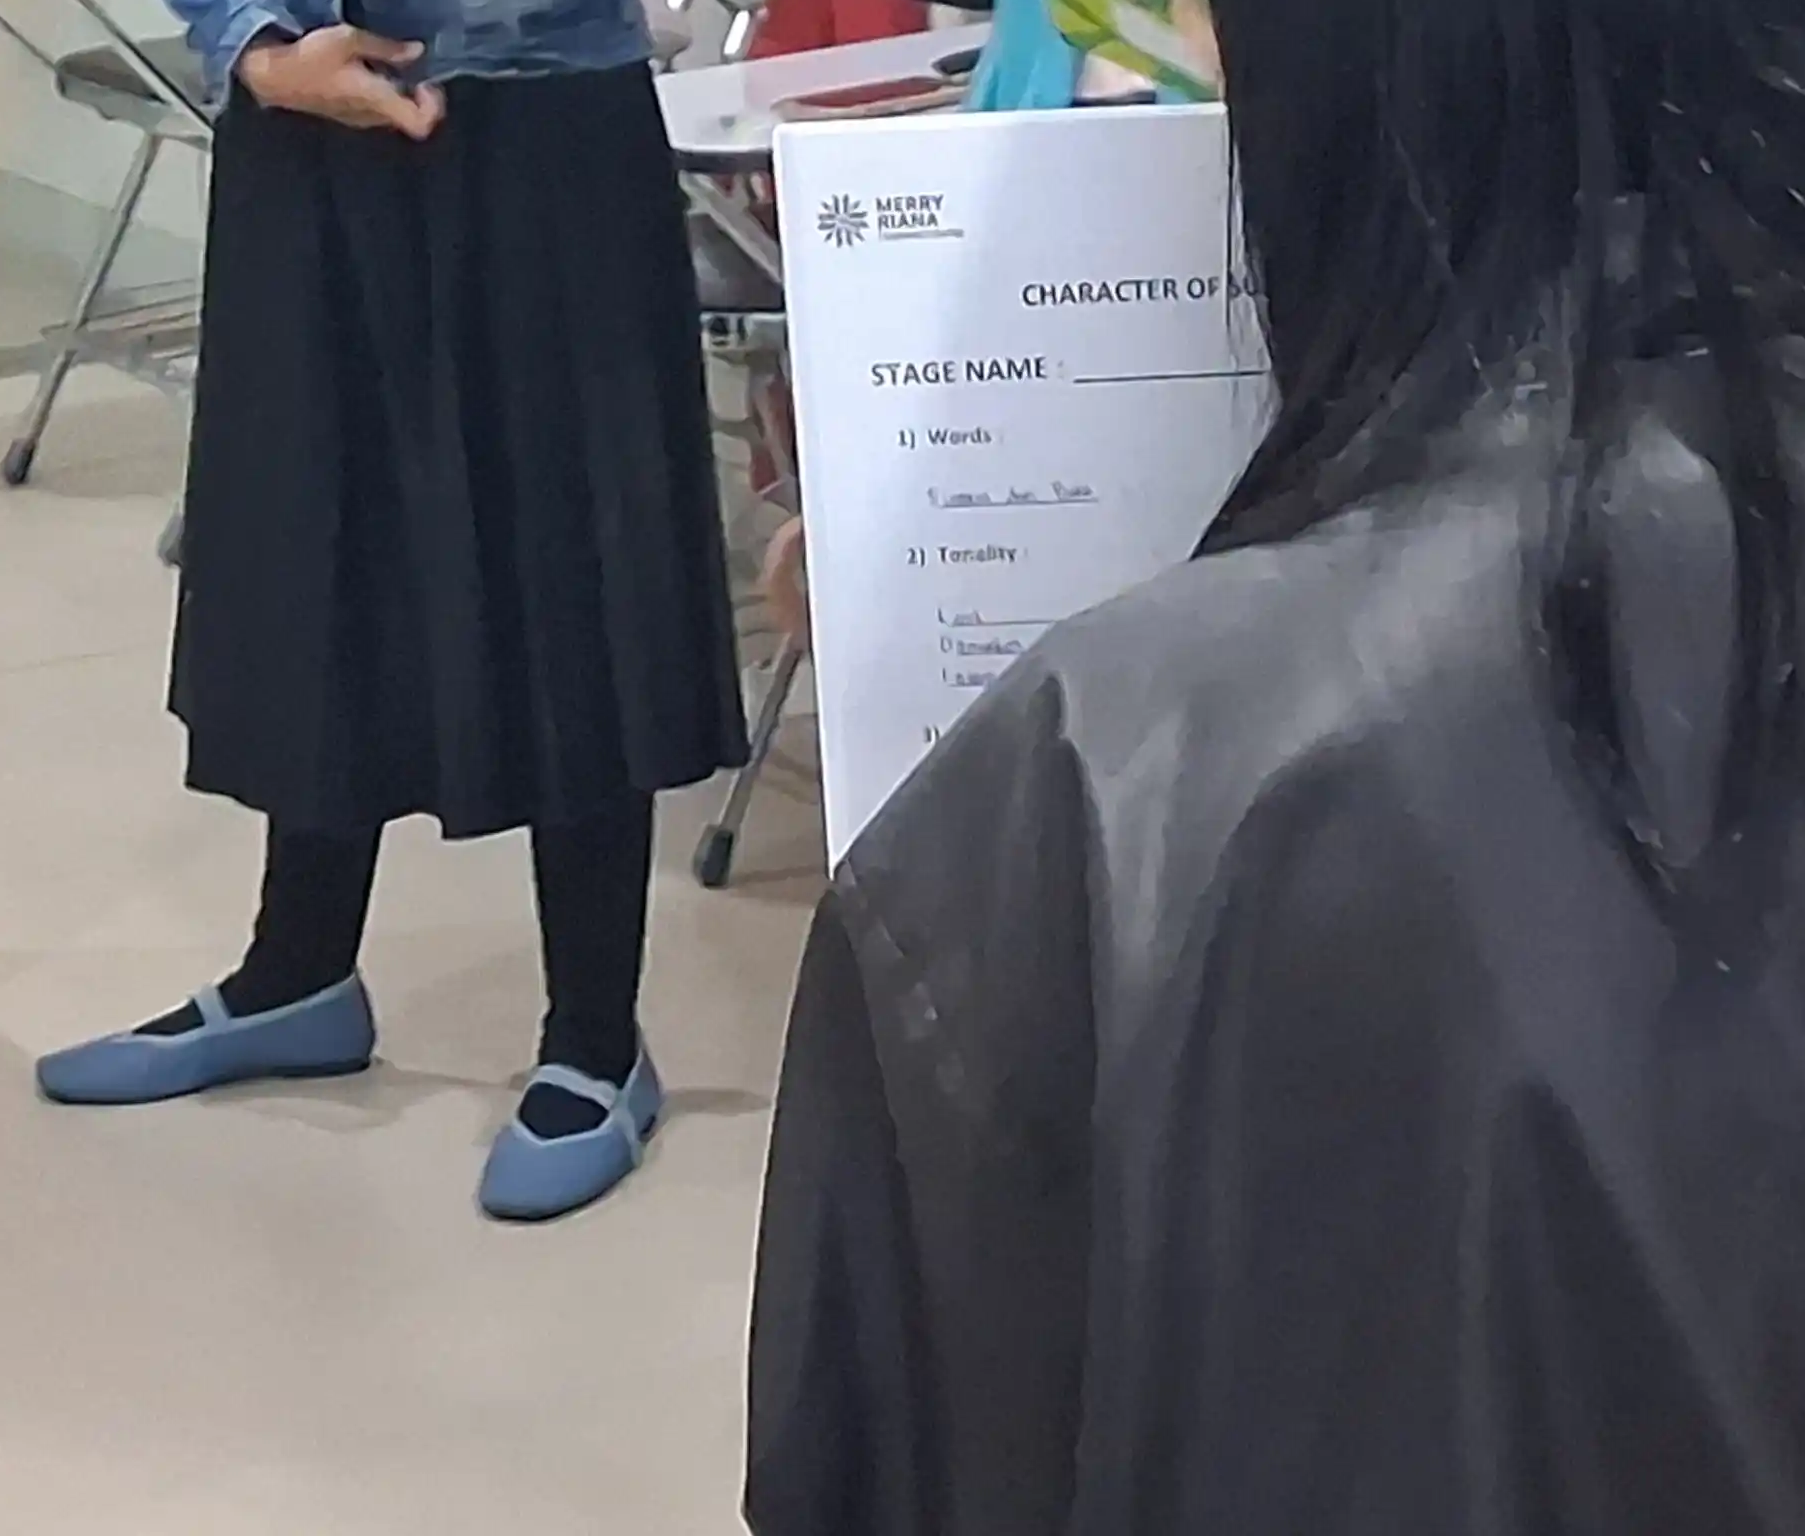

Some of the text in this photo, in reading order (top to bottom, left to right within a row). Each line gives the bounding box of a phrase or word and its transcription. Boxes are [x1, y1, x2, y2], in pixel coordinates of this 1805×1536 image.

[875, 193, 945, 212] MERRY
[877, 211, 939, 230] RIANA
[1021, 278, 1179, 308] CHARACTER
[1187, 276, 1220, 301] OF
[870, 356, 1047, 388] STAGE NAME
[927, 425, 992, 447] Words
